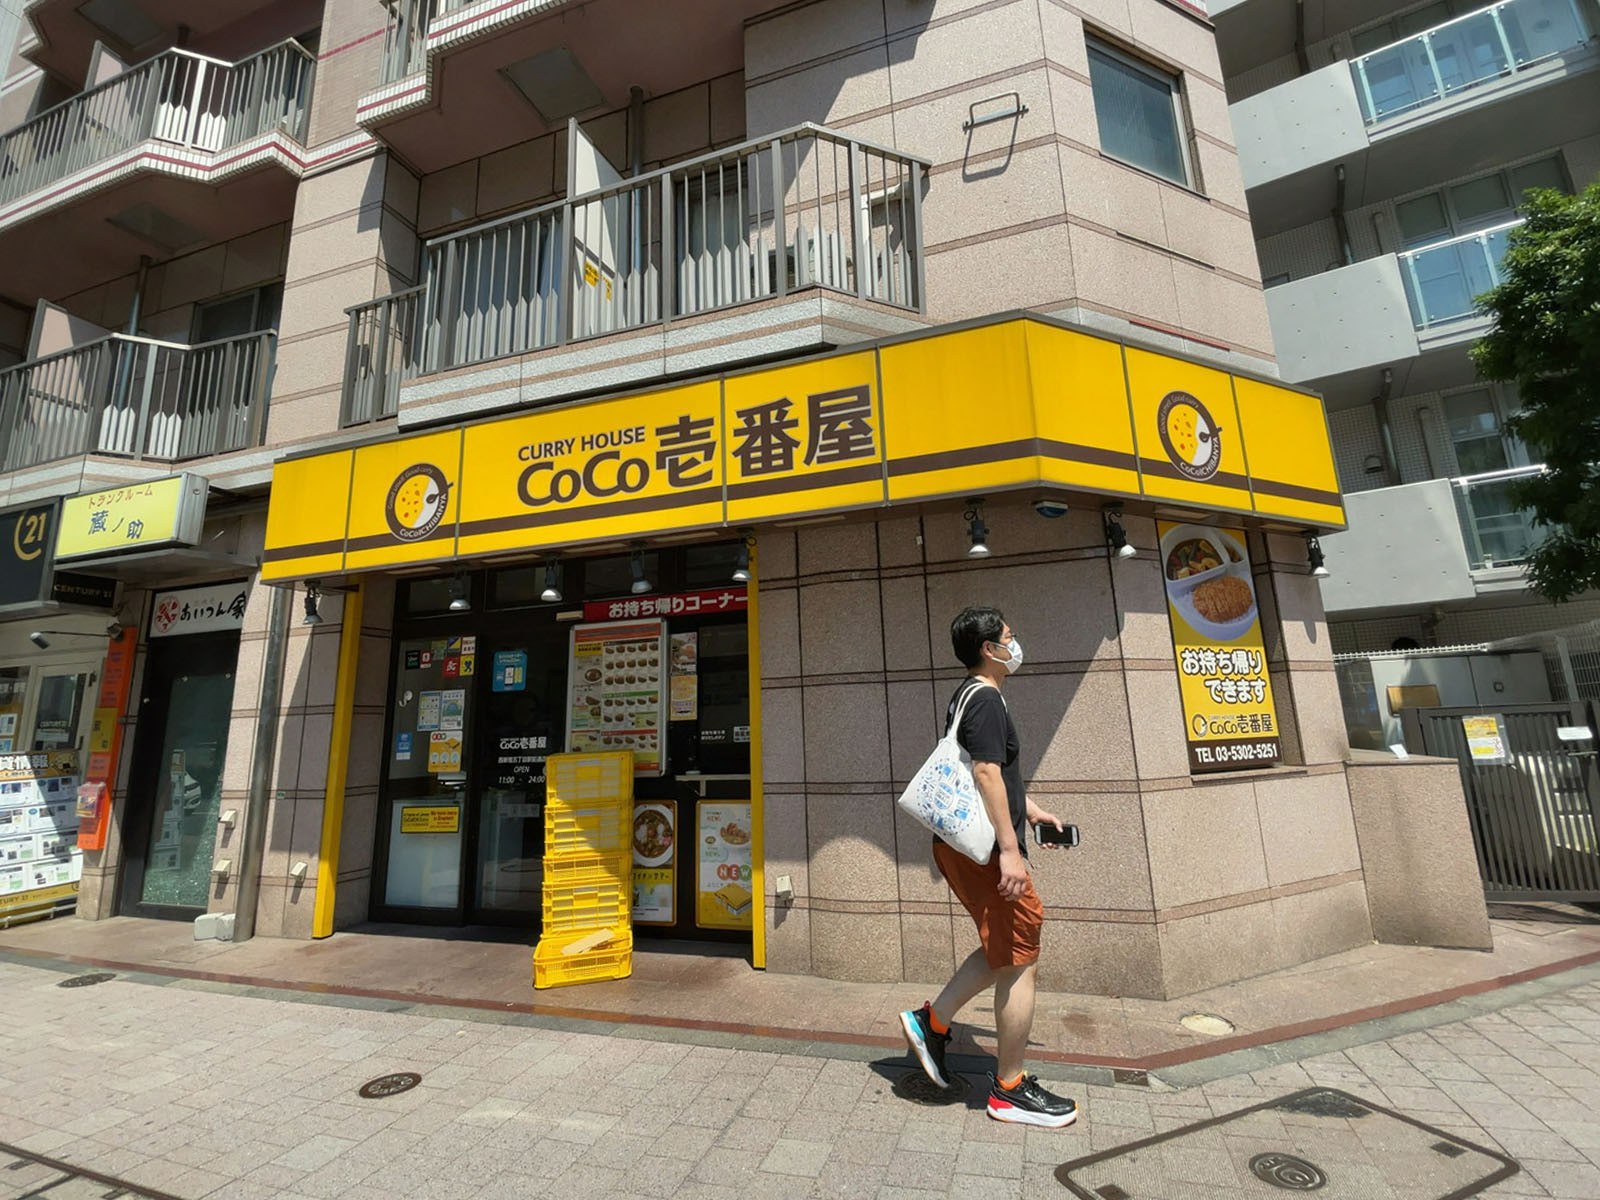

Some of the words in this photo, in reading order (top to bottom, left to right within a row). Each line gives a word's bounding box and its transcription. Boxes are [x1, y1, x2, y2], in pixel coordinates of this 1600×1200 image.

[518, 437, 577, 462] CURRY
[581, 426, 646, 452] HOUSE
[88, 484, 153, 508] トランクルーム
[88, 510, 144, 540] 蔵ノ助
[400, 493, 447, 538] CoCoICHIBANYA
[608, 592, 749, 618] お持ち帰りコーナー
[1180, 647, 1264, 676] お持ち帰り
[1204, 678, 1267, 704] できます
[1209, 713, 1274, 735] CoCo壱番屋
[1195, 747, 1215, 763] TEL
[1215, 743, 1278, 762] 03-5302-5251
[513, 765, 530, 773] OPEN
[719, 866, 750, 880] NEW
